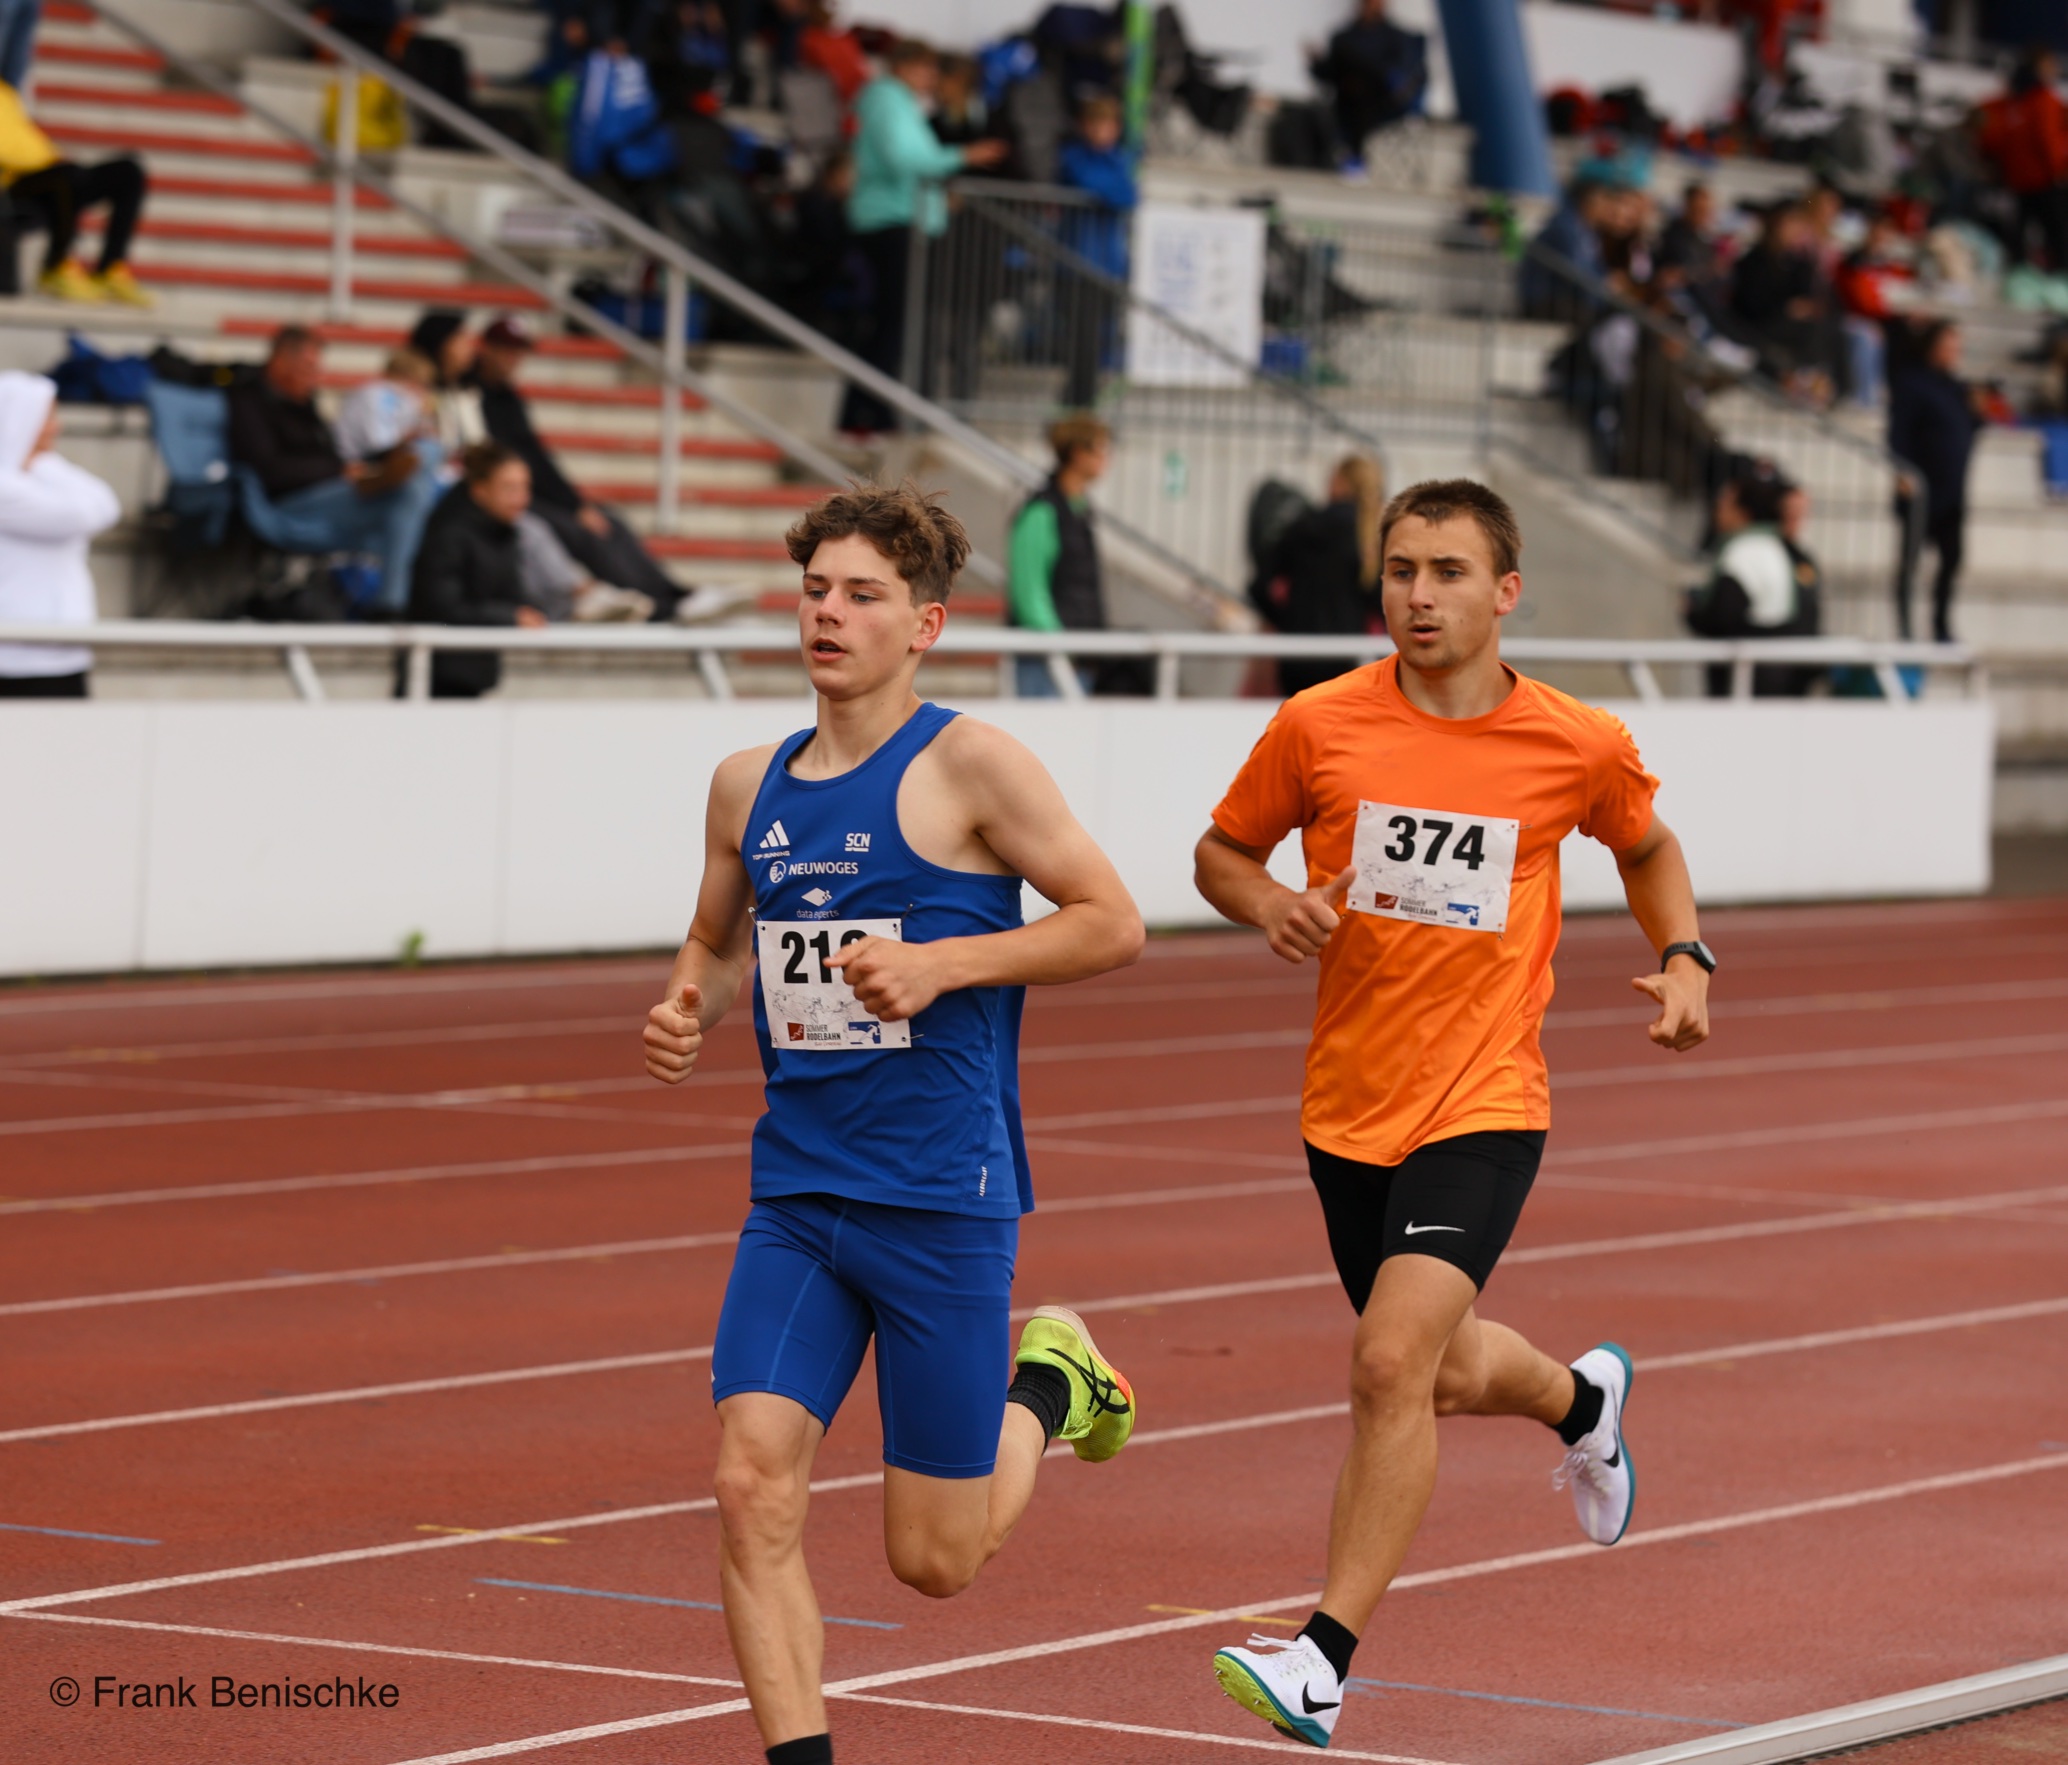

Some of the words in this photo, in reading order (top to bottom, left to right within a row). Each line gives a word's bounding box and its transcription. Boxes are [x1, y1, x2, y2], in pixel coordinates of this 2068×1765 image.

[845, 833, 871, 847] SCN
[1385, 815, 1485, 871] 374
[788, 862, 859, 875] NEUWOGES
[796, 909, 814, 918] data
[814, 908, 839, 921] eperts
[806, 1032, 841, 1041] RODELBAHN
